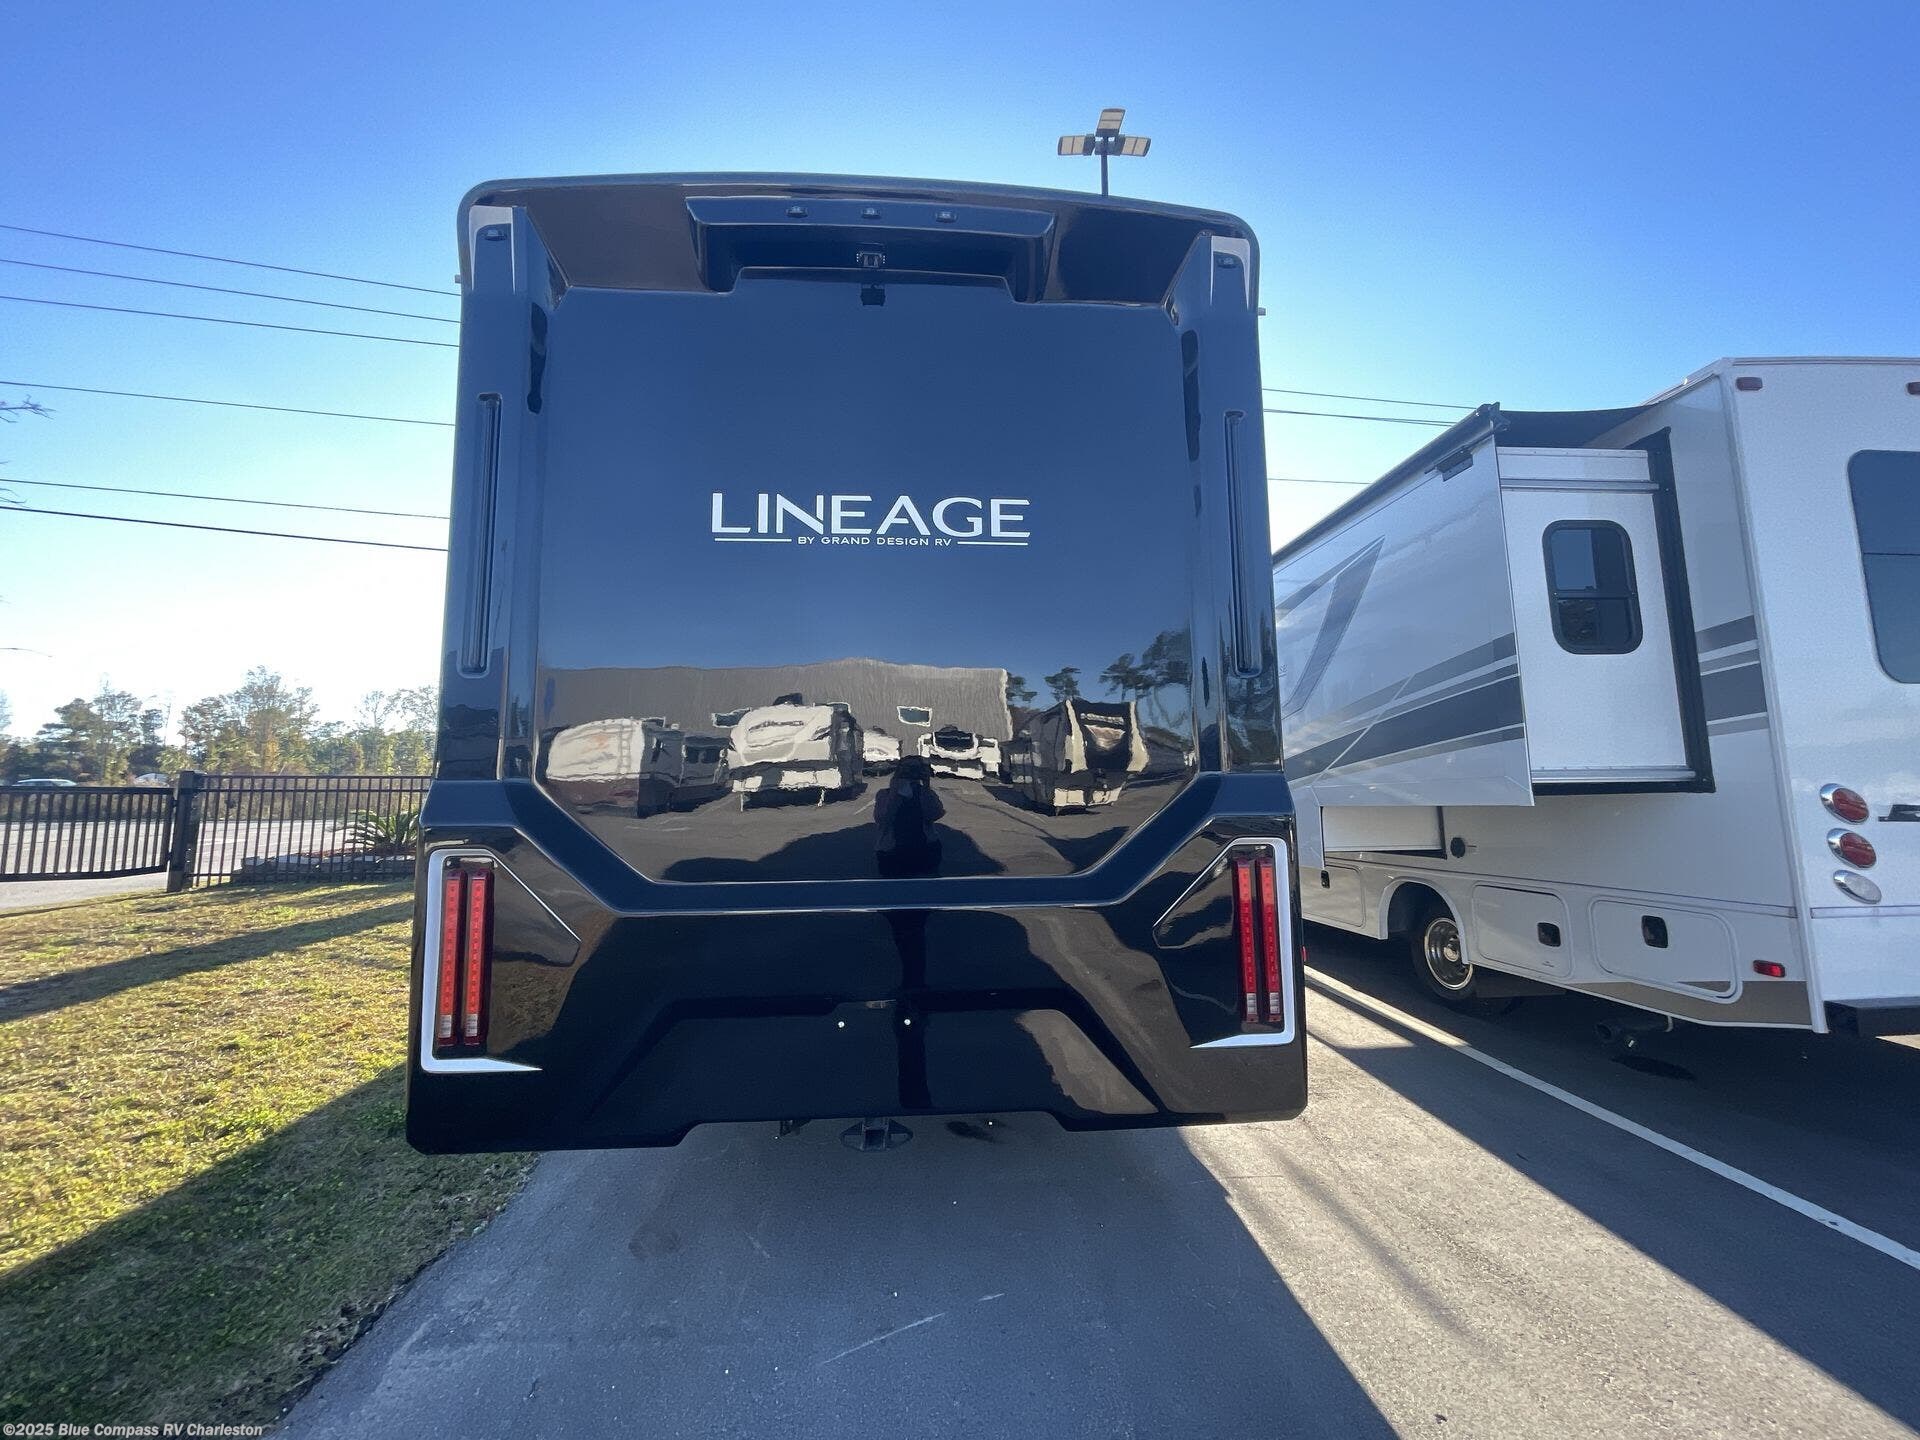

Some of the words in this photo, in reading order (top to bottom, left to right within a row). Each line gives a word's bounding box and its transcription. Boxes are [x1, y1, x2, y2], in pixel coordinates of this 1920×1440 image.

[711, 493, 1031, 538] LINEAGE
[797, 536, 816, 545] BY
[820, 536, 870, 545] GRAND
[876, 537, 929, 546] DESIGN
[934, 538, 952, 547] RV
